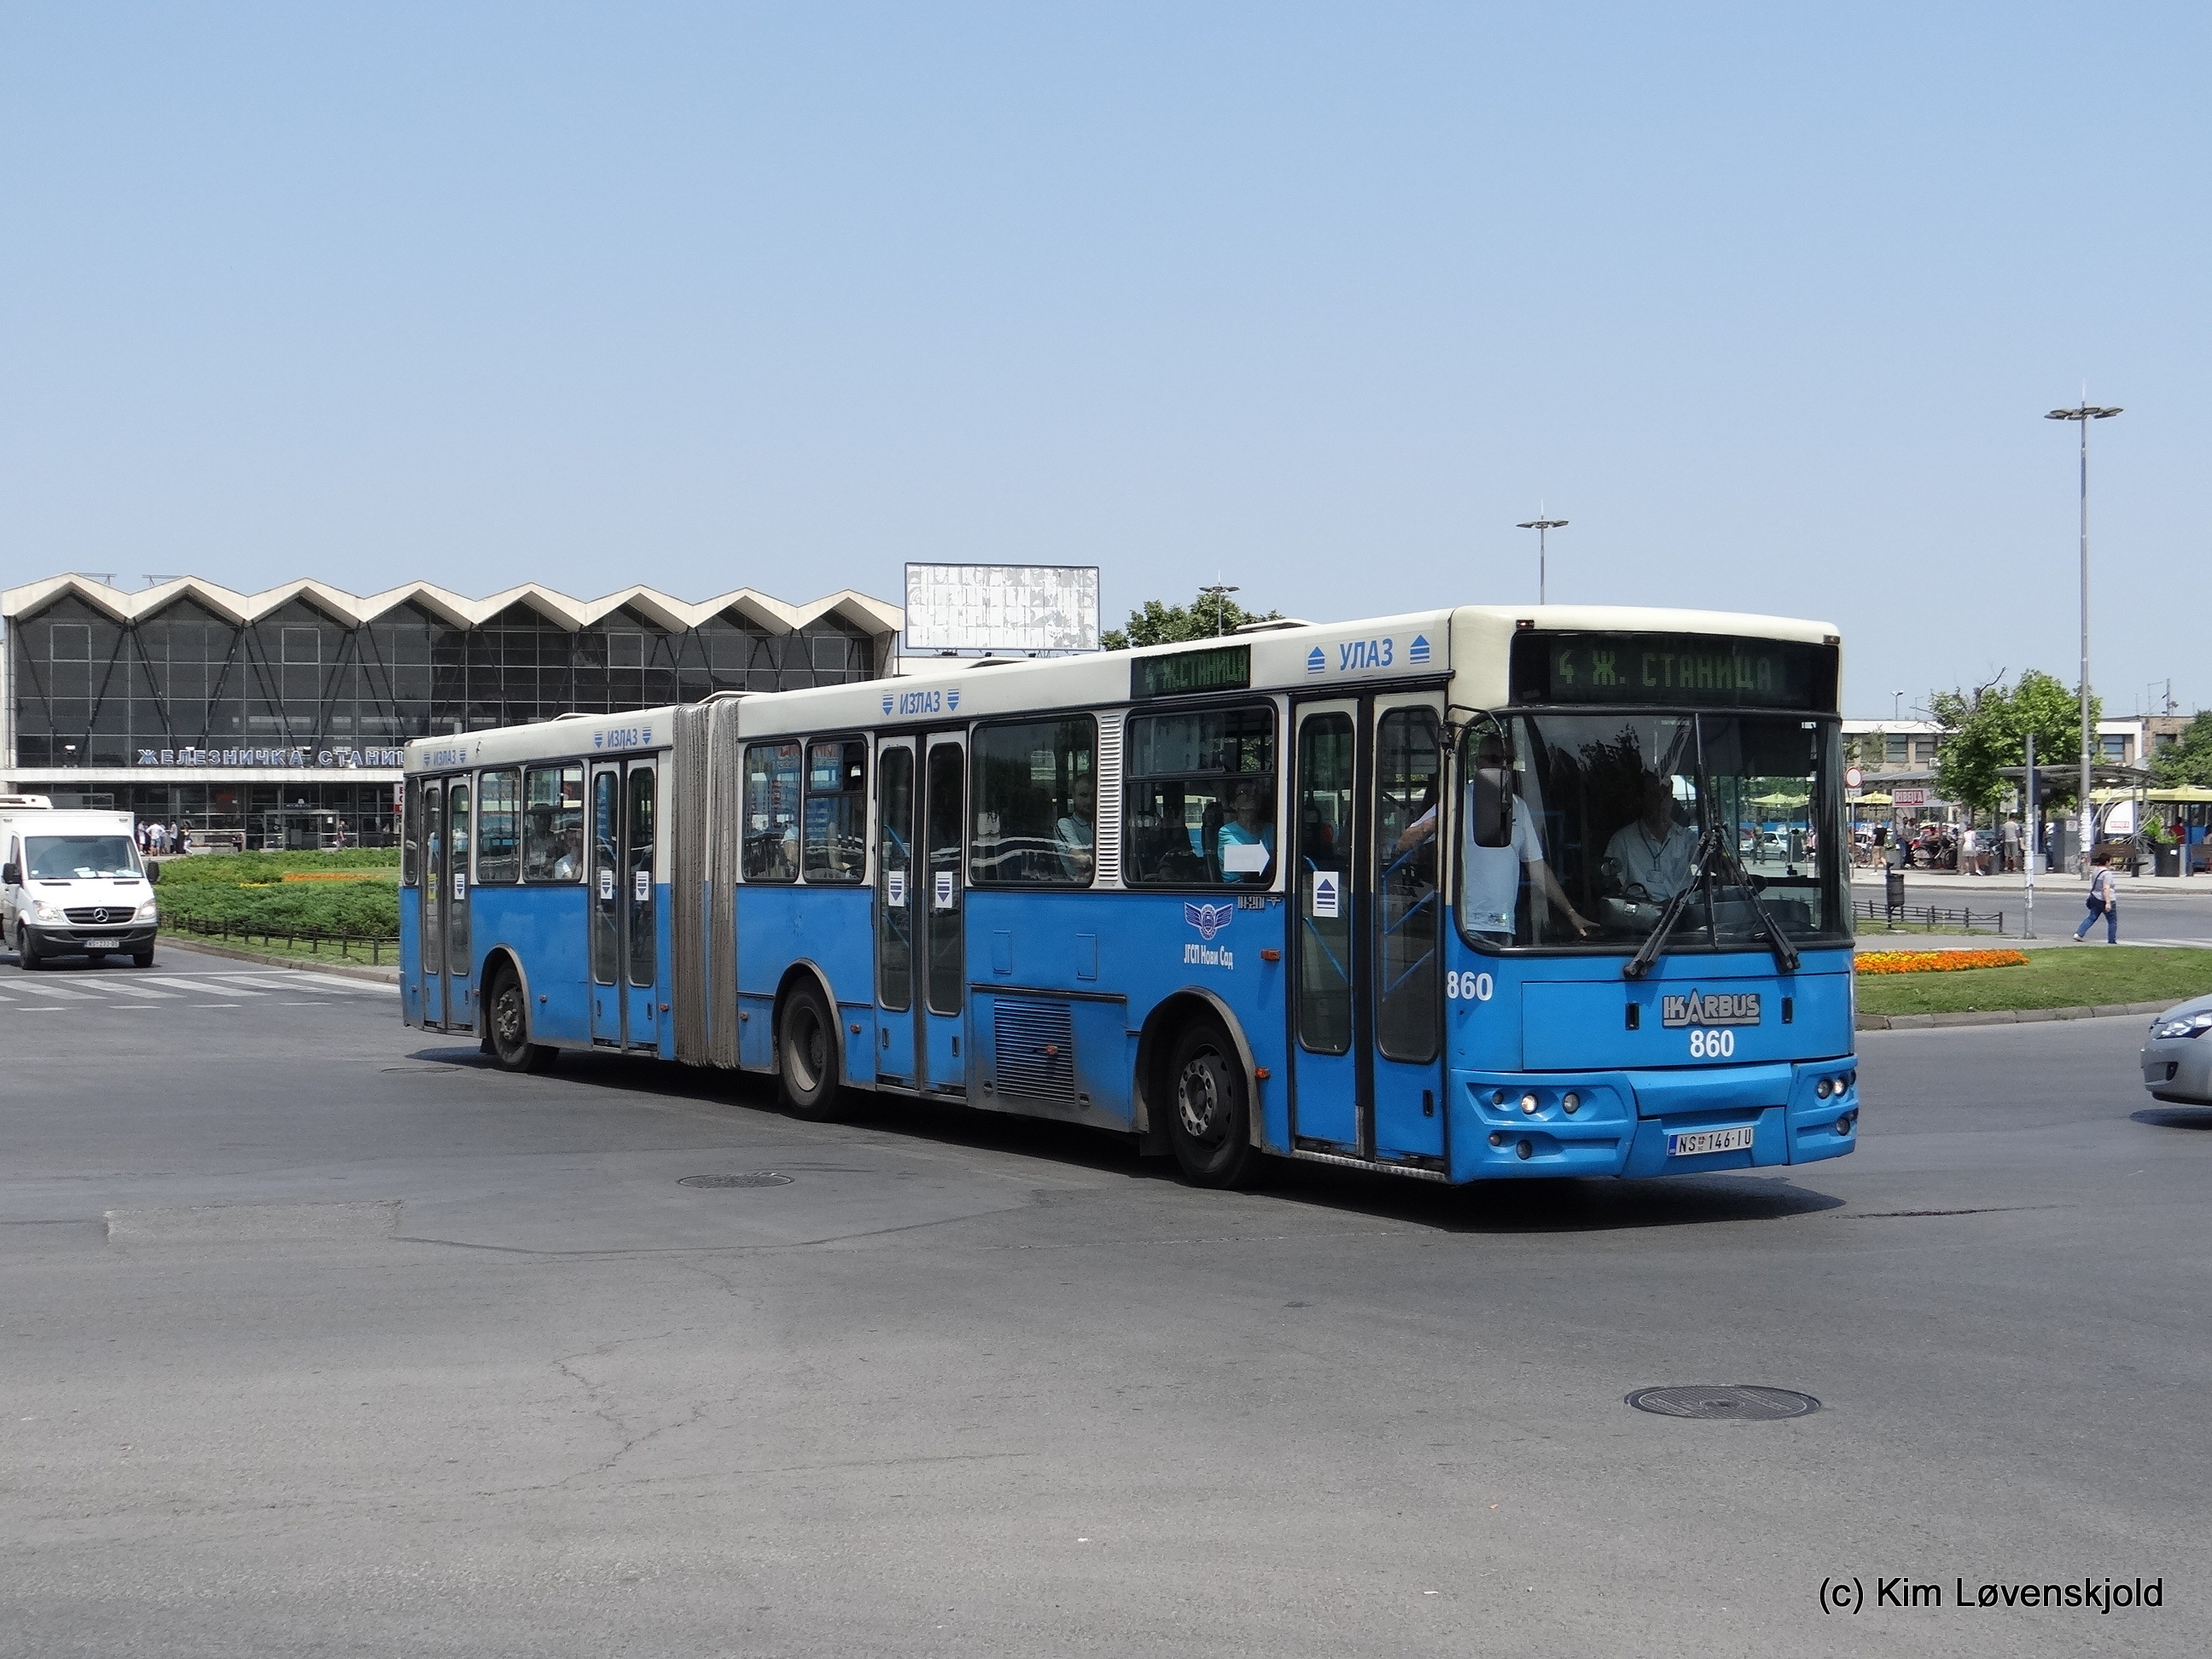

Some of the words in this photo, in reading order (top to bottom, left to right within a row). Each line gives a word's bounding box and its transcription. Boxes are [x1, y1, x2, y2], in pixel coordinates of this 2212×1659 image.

[1340, 638, 1394, 671] УЛАЗ
[1642, 651, 1772, 690] СТАНИЦА
[899, 690, 940, 714] ИЗЛАЗ
[608, 729, 637, 748] ИЗЛАЗ
[138, 749, 303, 765] ЖЕЛЕЗНИЧКА
[434, 750, 457, 766] ИЗЛАЗ
[1201, 945, 1219, 965] Нови
[1220, 946, 1234, 969] Сад
[1447, 971, 1493, 1001] 860
[1663, 990, 1760, 1025] IKARBUS
[1690, 1030, 1734, 1057] 860
[1679, 1136, 1697, 1153] NS
